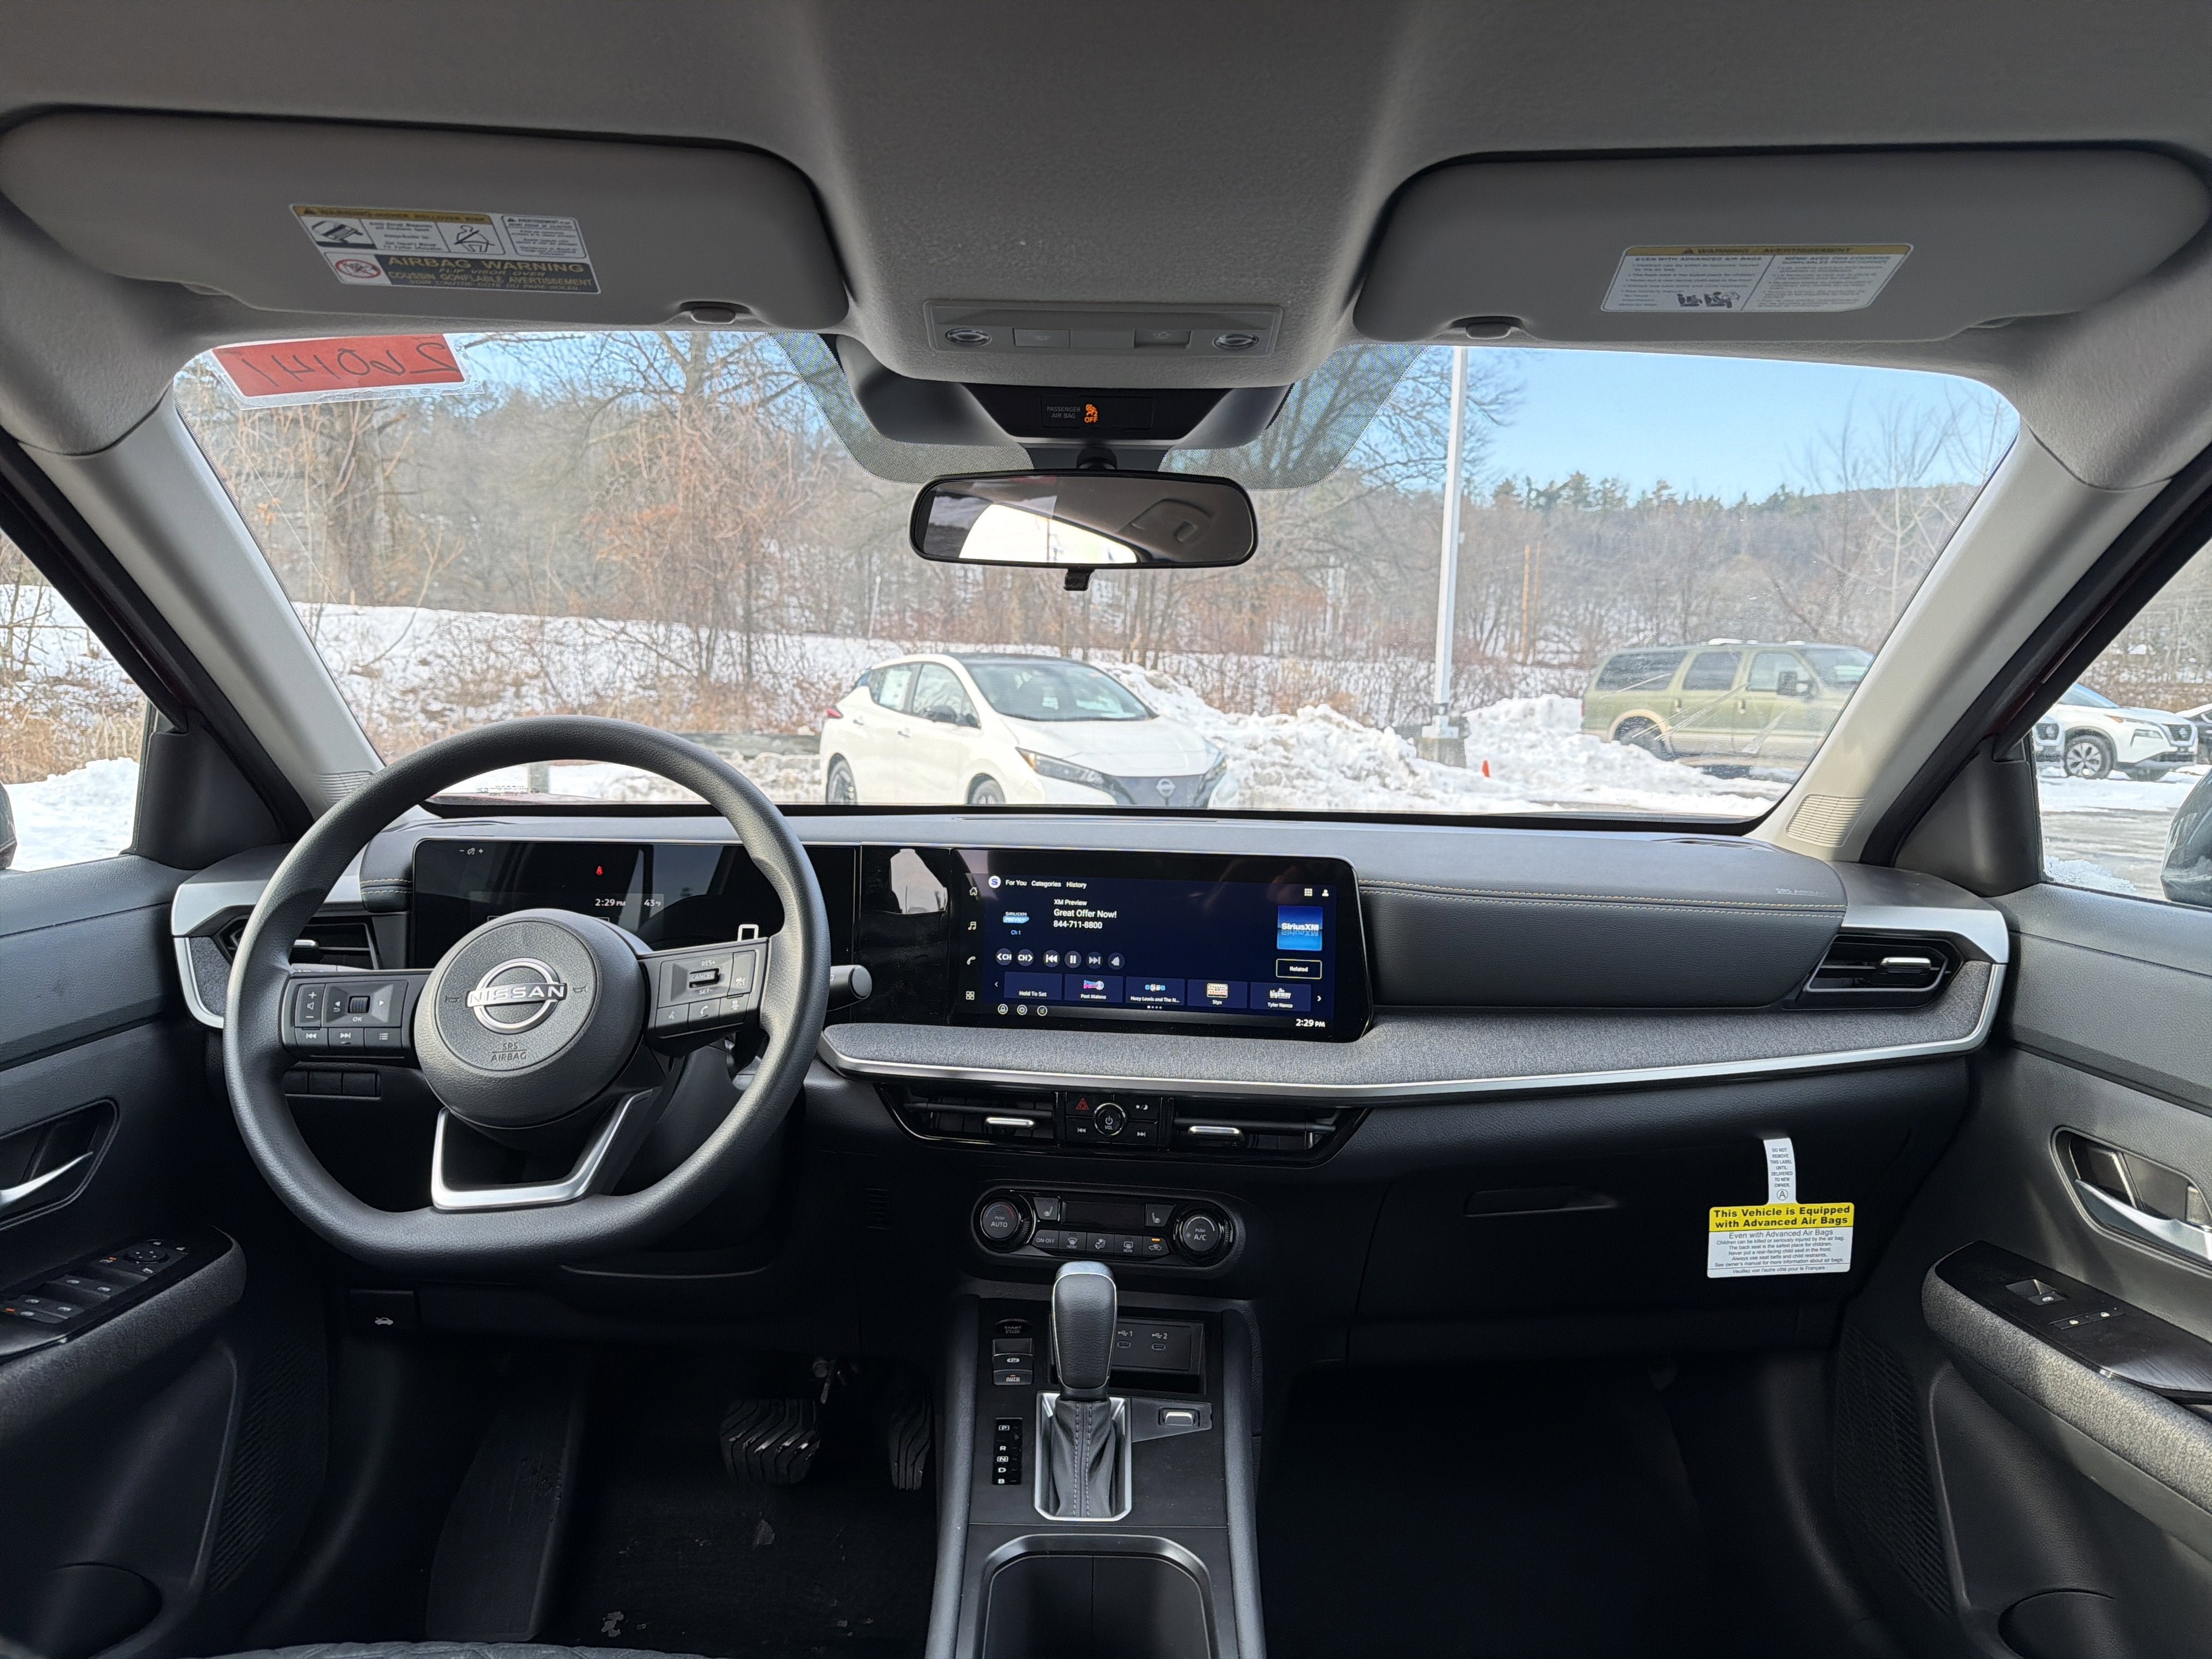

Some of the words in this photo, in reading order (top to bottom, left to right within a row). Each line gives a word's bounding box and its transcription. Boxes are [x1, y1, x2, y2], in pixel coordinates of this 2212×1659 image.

[388, 257, 471, 268] AIRBAG
[481, 260, 584, 273] WARNING
[441, 273, 504, 283] GONFLABLE
[509, 276, 592, 285] AVERTISSEMENT
[1031, 880, 1062, 888] Categories
[1053, 909, 1075, 917] Great
[1076, 909, 1096, 917] Offer
[1097, 910, 1118, 918] Now!
[1053, 920, 1103, 929] 844-711-8800
[1281, 923, 1319, 931] SiriusXM
[470, 986, 565, 1004] NISSAN
[1295, 1018, 1314, 1027] 2:29
[490, 1052, 527, 1063] AIRBAG
[1779, 1190, 1786, 1198] A
[1741, 1207, 1782, 1216] Vehicle
[1799, 1205, 1850, 1216] Equipped
[1716, 1220, 1739, 1228] with
[1743, 1217, 1797, 1227] Advanced
[1821, 1216, 1848, 1225] Bags
